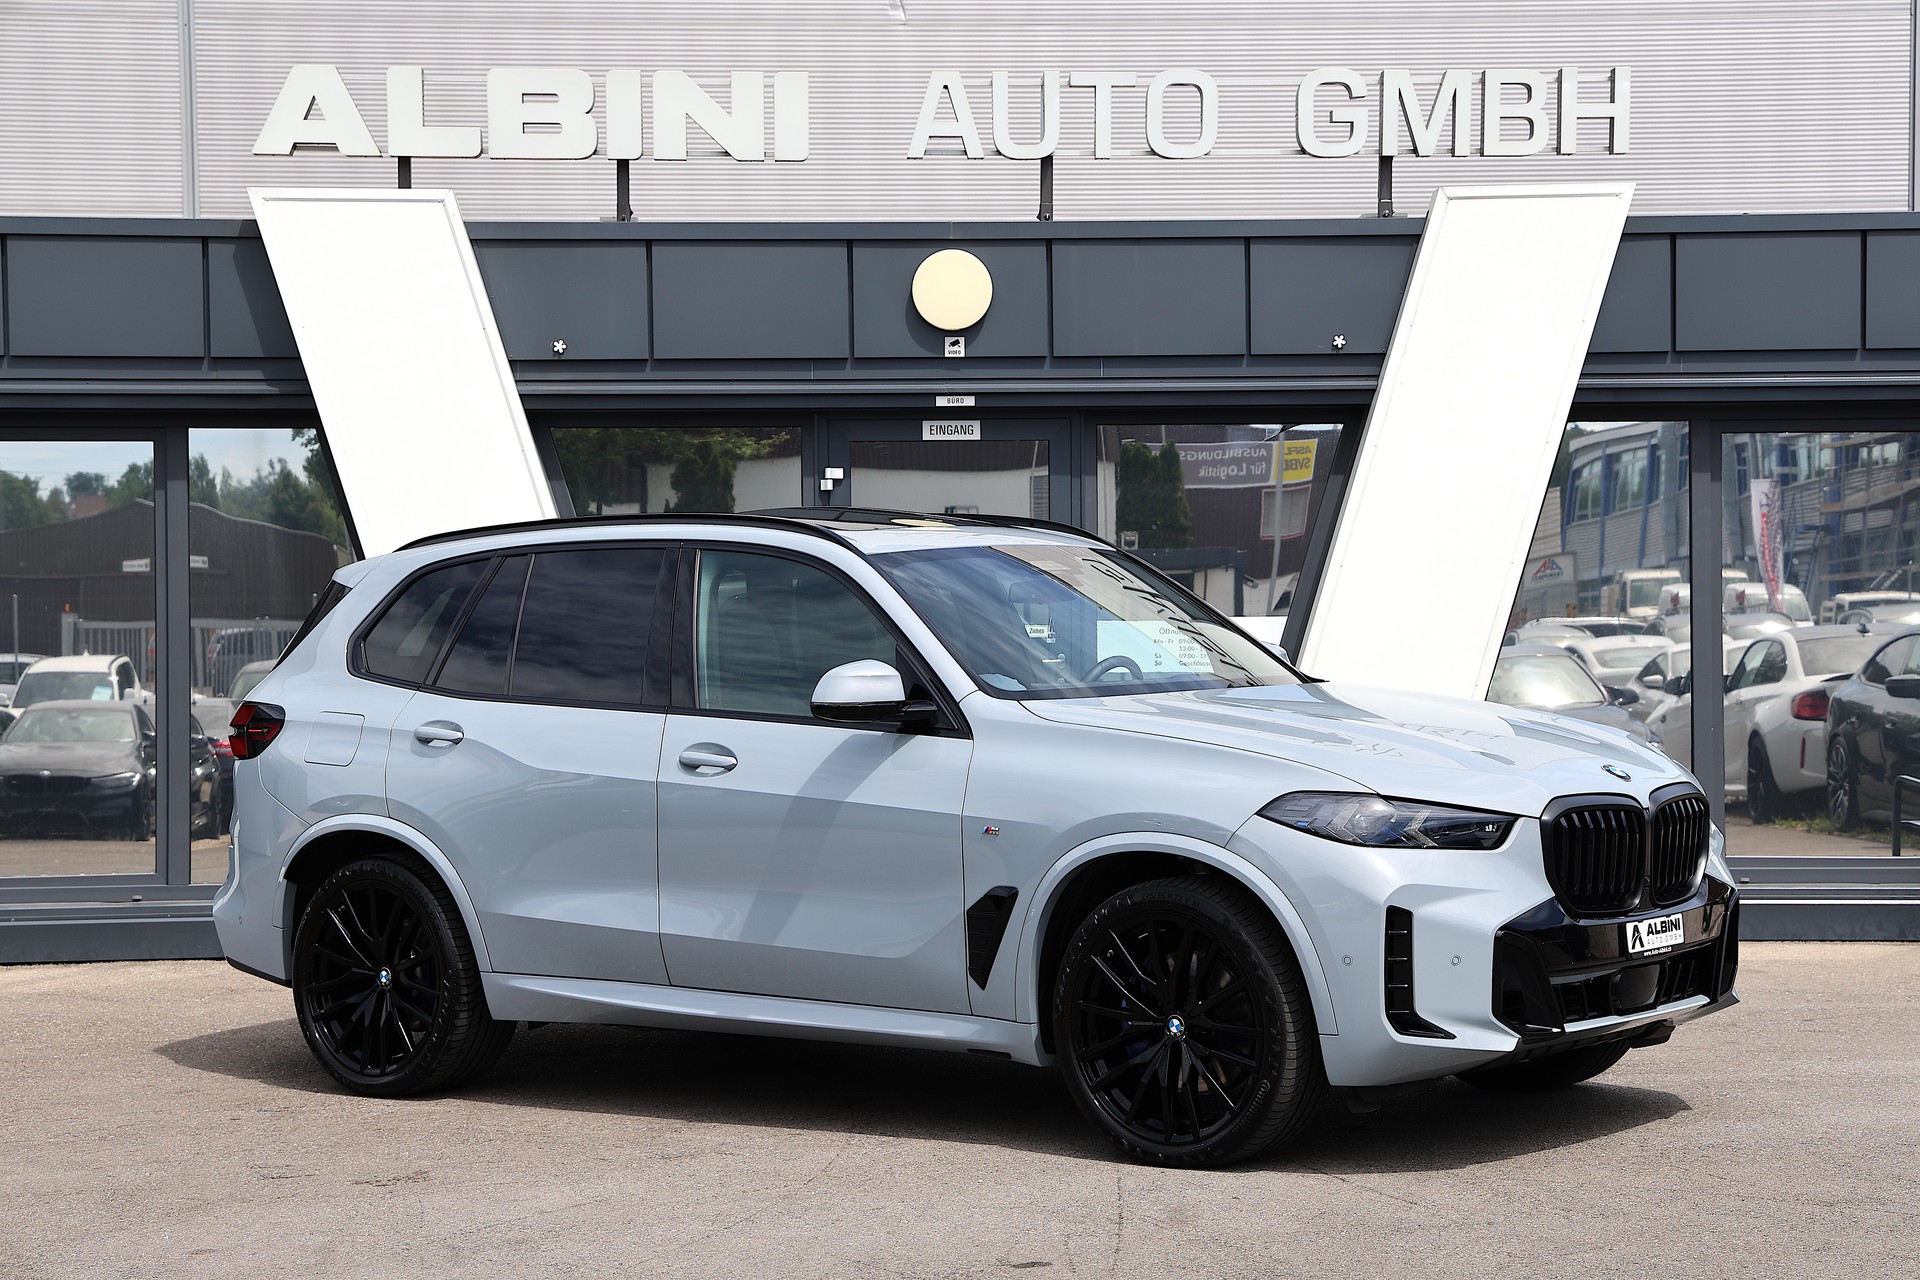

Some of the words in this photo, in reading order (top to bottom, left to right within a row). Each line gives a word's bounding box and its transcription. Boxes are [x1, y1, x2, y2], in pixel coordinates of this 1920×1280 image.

[251, 64, 810, 162] ALBINI
[906, 67, 1219, 159] AUTO
[1296, 66, 1632, 158] GMBH
[929, 424, 974, 436] EINGANG
[1646, 917, 1681, 937] ALBINI
